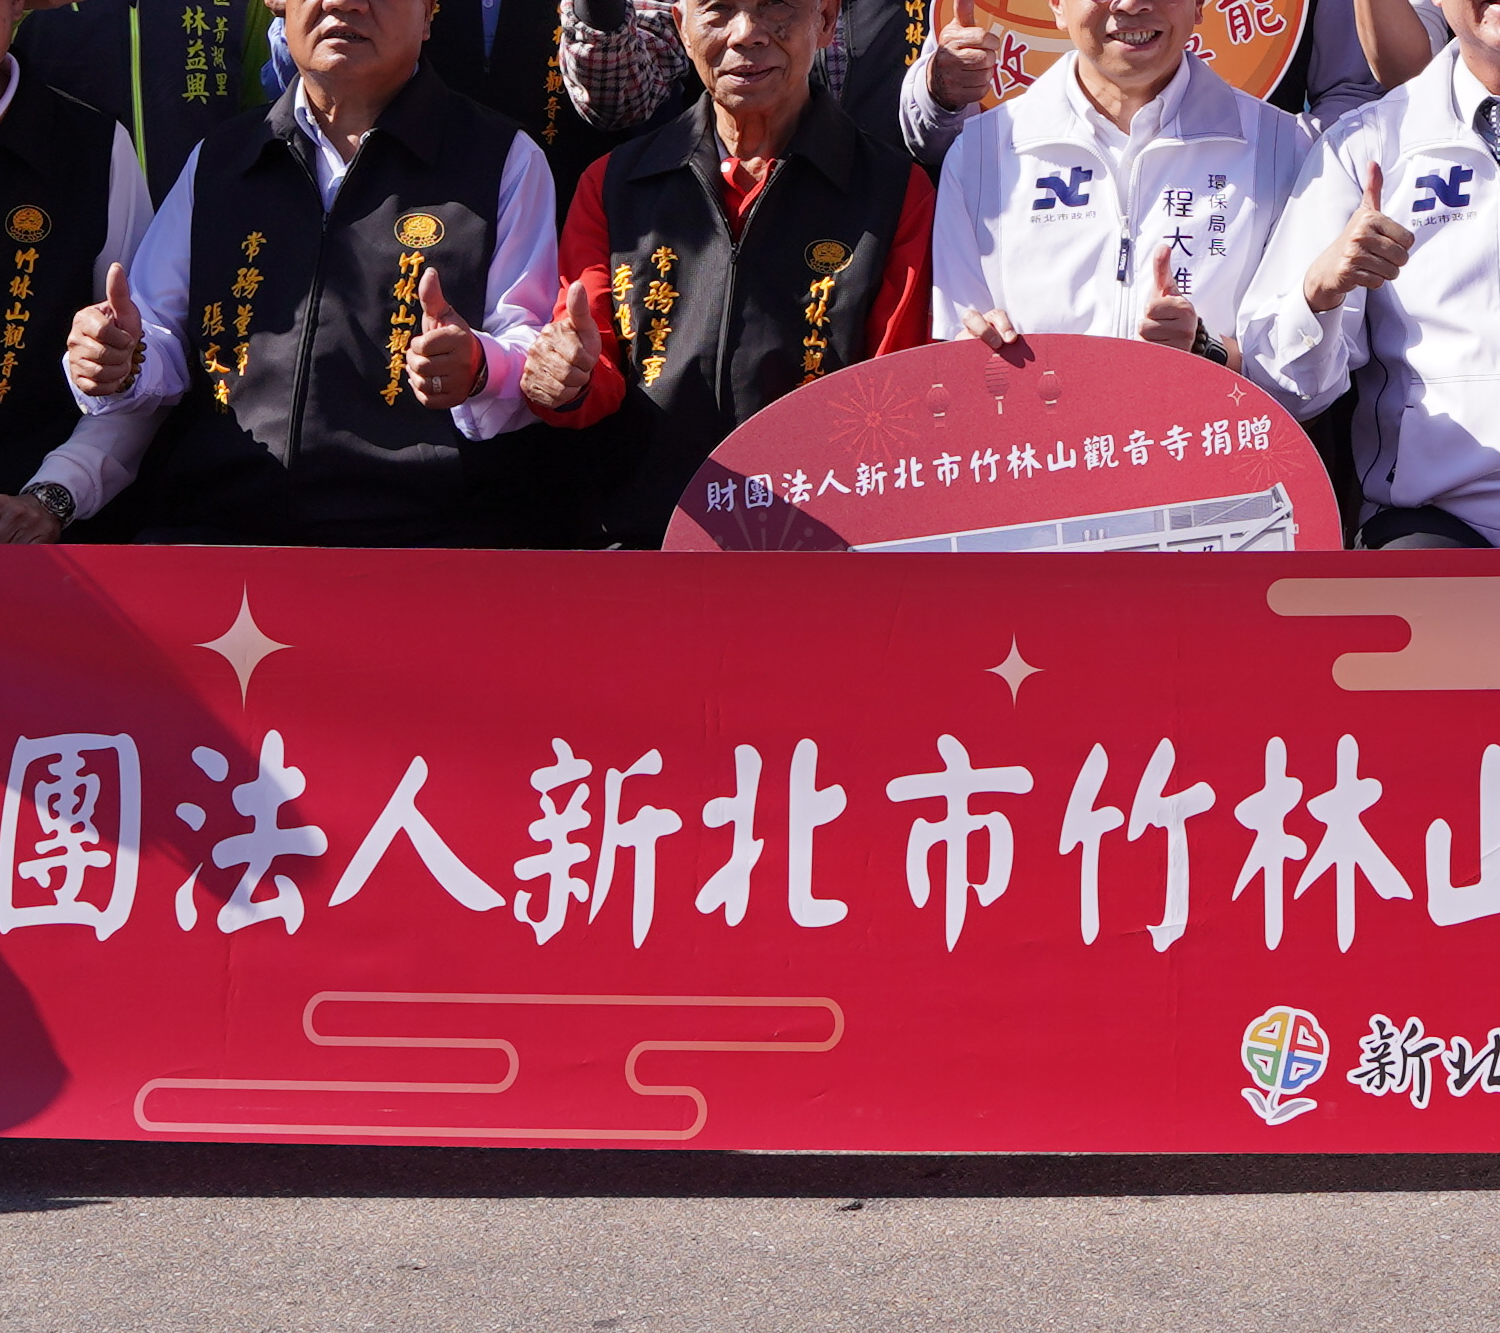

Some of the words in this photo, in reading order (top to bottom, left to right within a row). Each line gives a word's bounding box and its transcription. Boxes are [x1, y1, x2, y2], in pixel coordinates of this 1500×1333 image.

[180, 5, 210, 105] 林益興
[1030, 210, 1096, 224] 新北市政府
[1207, 173, 1227, 257] 環保局長
[1411, 210, 1478, 228] 新北市政府
[230, 231, 267, 377] 常務董事
[379, 251, 426, 407] 竹林山觀音寺
[641, 246, 680, 388] 常務董事
[706, 415, 1272, 514] 財團法人新北市竹林山觀音寺捐贈
